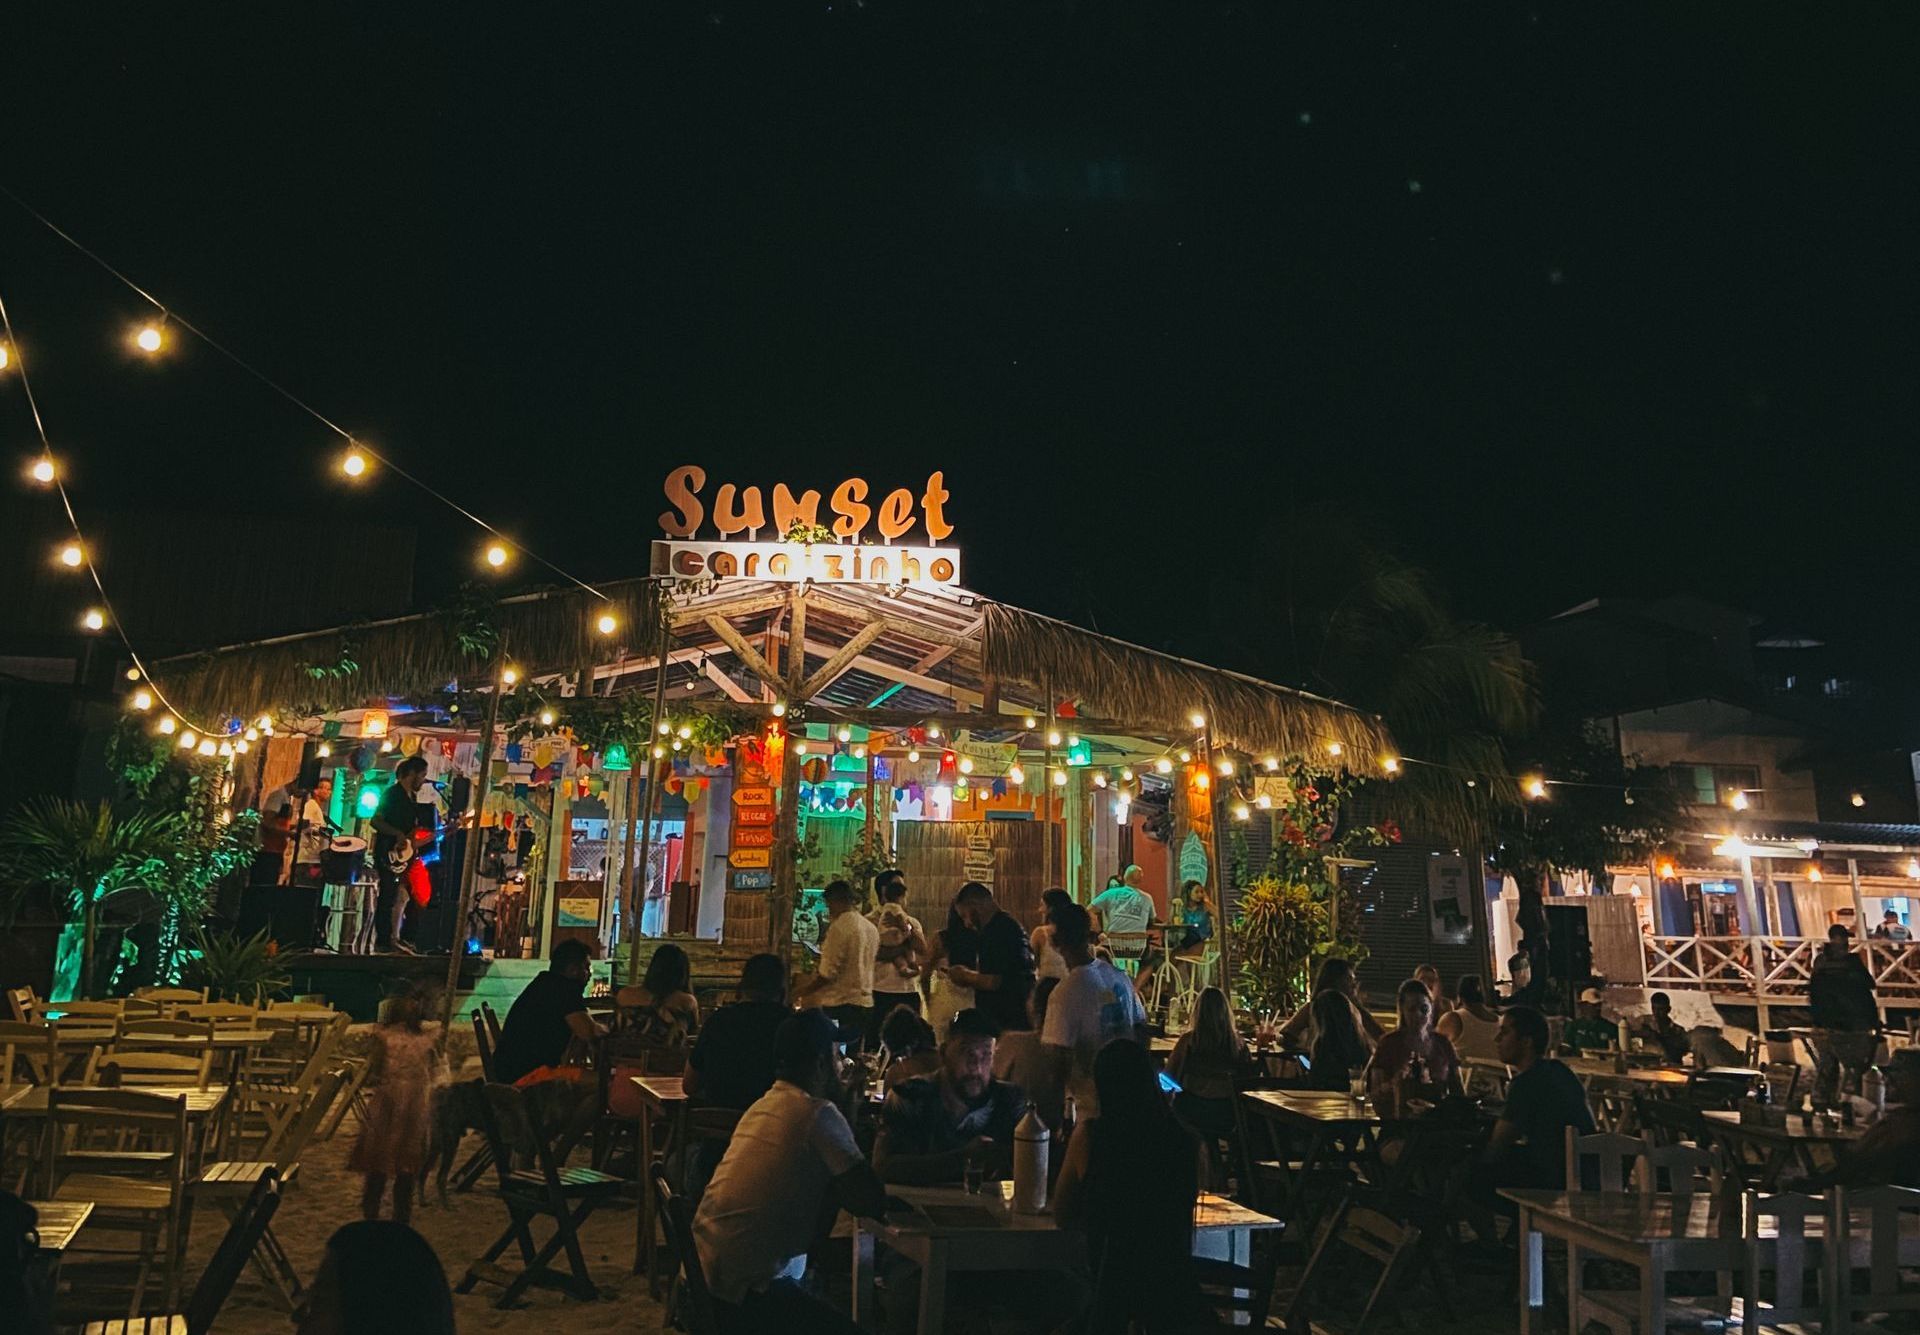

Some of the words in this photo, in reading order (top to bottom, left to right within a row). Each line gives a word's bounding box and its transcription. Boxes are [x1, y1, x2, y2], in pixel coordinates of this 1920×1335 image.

[742, 792, 765, 800] ROCK
[741, 812, 767, 821] REGGAE
[742, 874, 759, 887] Pop
